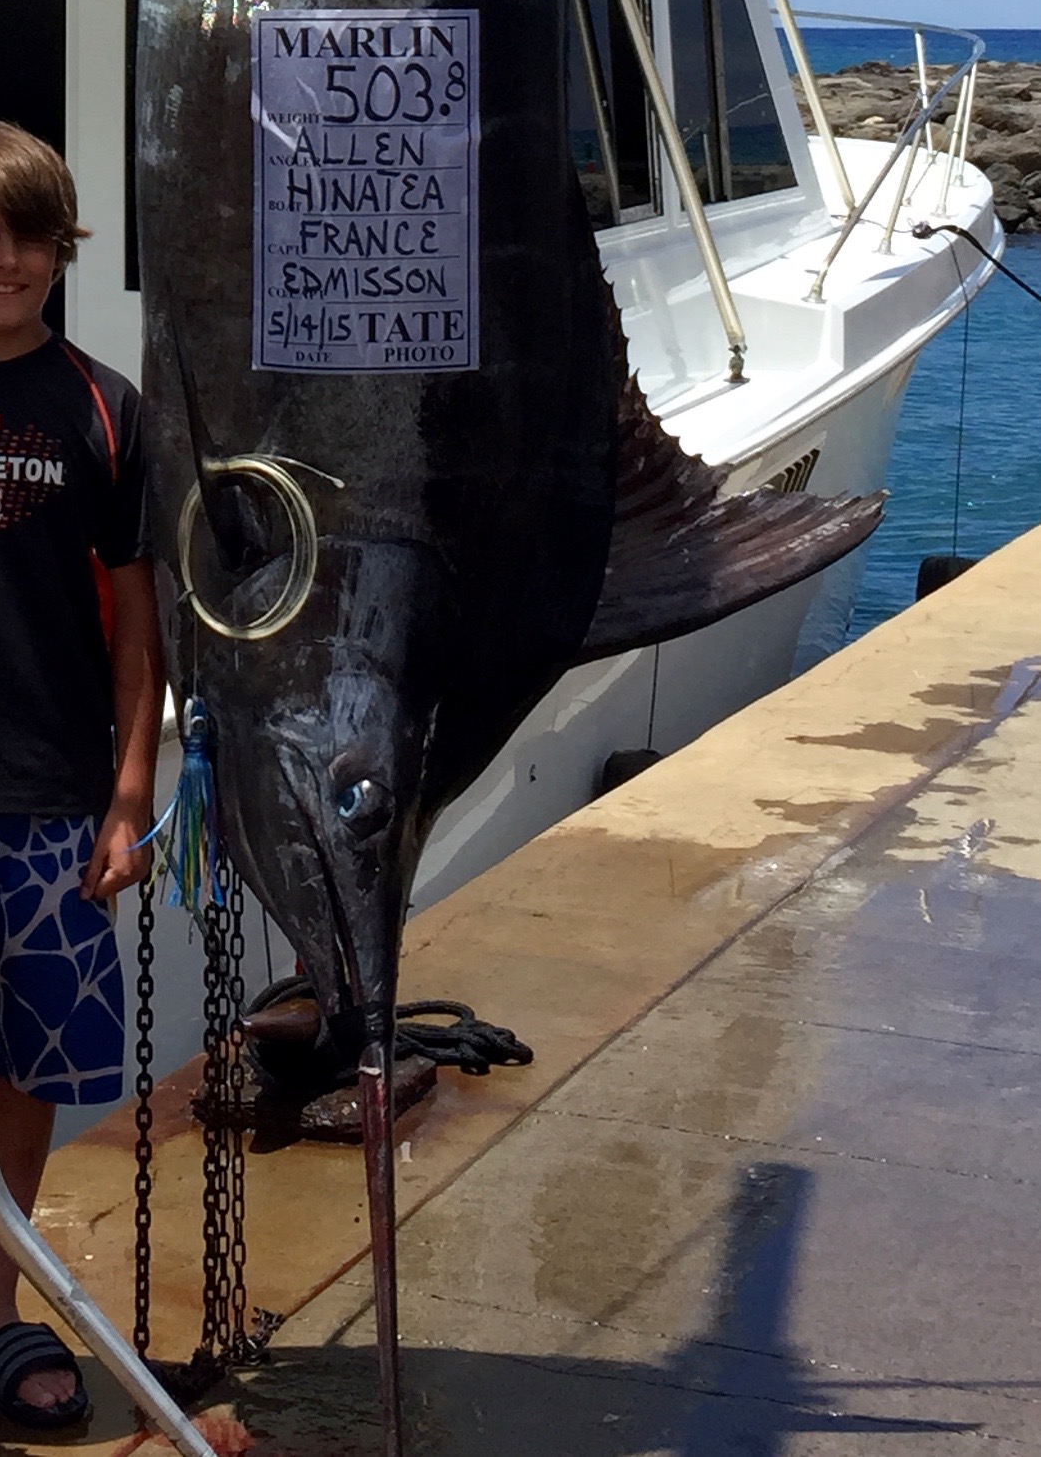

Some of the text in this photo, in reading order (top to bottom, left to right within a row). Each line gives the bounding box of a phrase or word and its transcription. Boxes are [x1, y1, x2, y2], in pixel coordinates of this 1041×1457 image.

[274, 25, 456, 59] MARLIN
[266, 112, 321, 124] WEIGHT
[292, 126, 425, 167] ALLEN
[268, 168, 445, 213] BOT HINATEA
[299, 219, 440, 258] FRANCE
[282, 261, 448, 299] EDMISSON
[267, 301, 352, 351] 5/14/15
[359, 309, 465, 343] TATE
[295, 351, 333, 363] DATE
[384, 346, 455, 364] PHOTO
